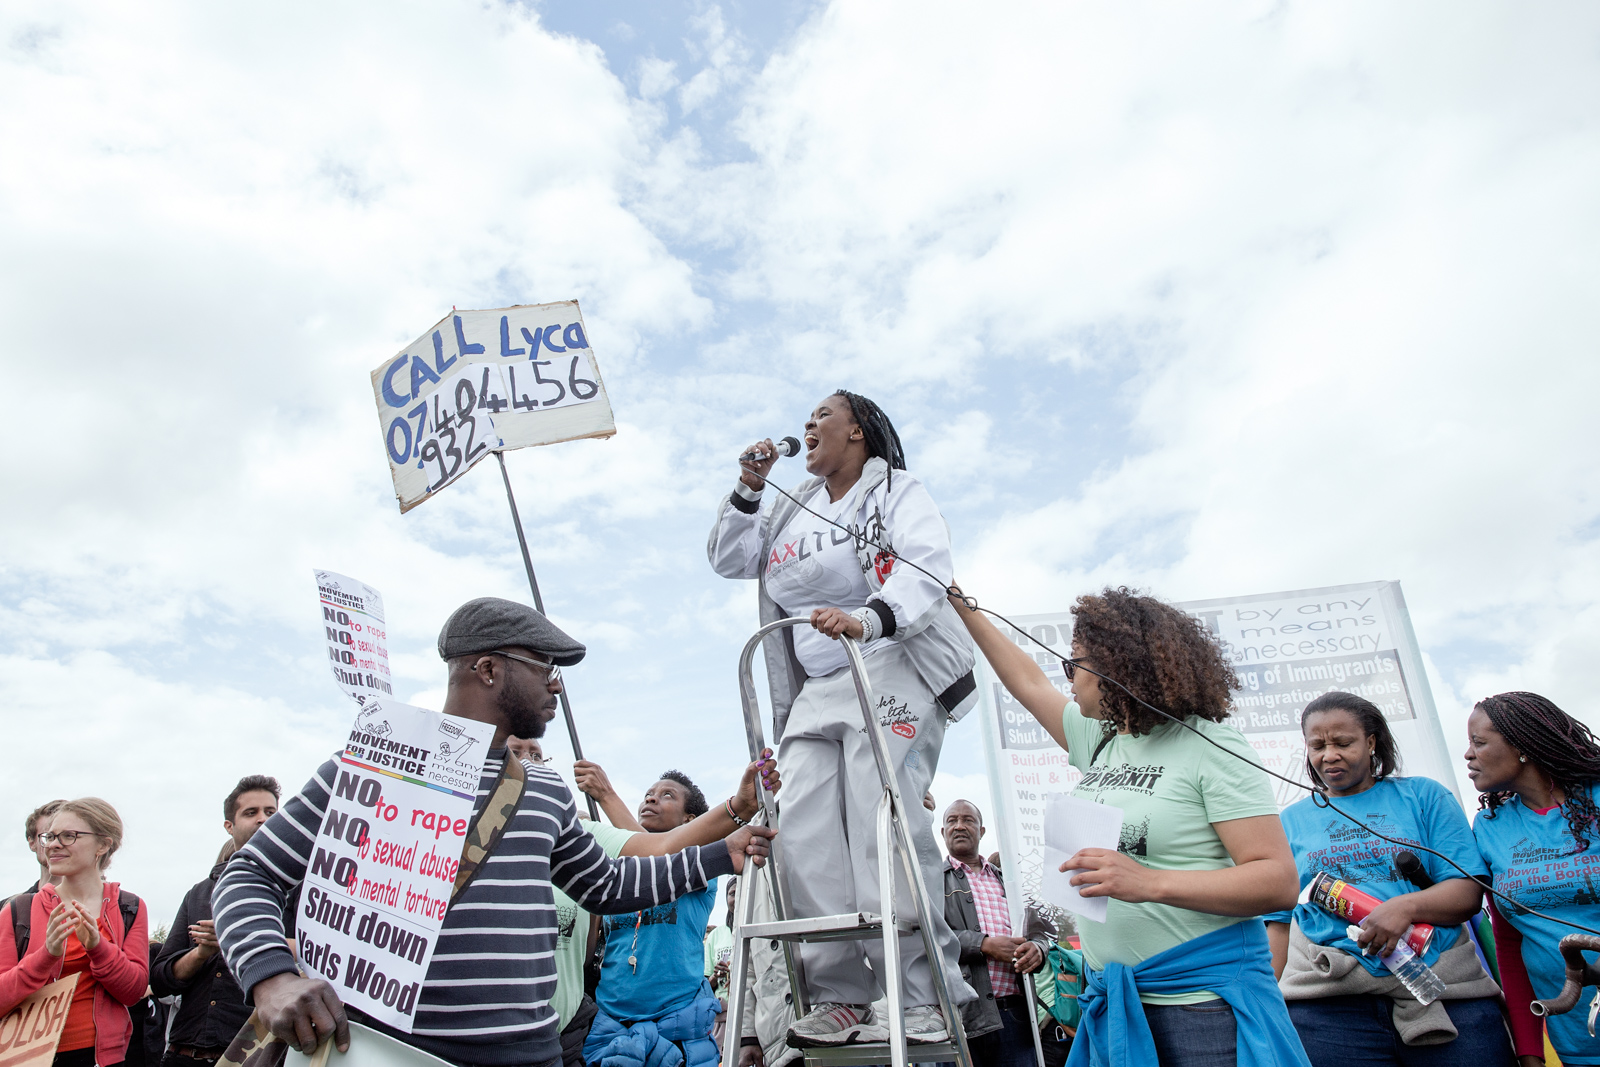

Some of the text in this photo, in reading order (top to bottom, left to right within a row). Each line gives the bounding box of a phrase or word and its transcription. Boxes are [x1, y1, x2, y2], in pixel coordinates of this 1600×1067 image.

[382, 315, 589, 408] CALL Lyca
[421, 415, 487, 491] 932
[318, 586, 364, 603] MOVEMENT
[333, 595, 365, 611] JUSTICE
[1235, 607, 1283, 622] by
[1296, 597, 1372, 615] any
[323, 606, 350, 626] NO
[348, 619, 362, 632] to
[366, 625, 387, 641] rape
[1240, 614, 1377, 639] means
[326, 626, 352, 646] NO
[347, 634, 356, 651] to
[1243, 632, 1382, 661] necessary
[328, 646, 355, 666] NO
[350, 654, 358, 669] to
[333, 666, 393, 696] Shut down
[1263, 664, 1281, 685] of
[1287, 655, 1395, 687] Immigrants
[1004, 709, 1035, 727] Ope
[1232, 688, 1324, 709] mmigration
[441, 722, 463, 736] FREEDOM
[1008, 728, 1038, 744] Shut
[1249, 710, 1290, 728] Raids
[349, 730, 431, 762] MOVEMENT
[345, 743, 427, 777] FOR JUSTICE
[431, 763, 479, 780] means
[433, 753, 482, 772] by any
[1011, 752, 1069, 768] Building
[1121, 762, 1166, 774] Racist
[428, 770, 478, 793] necessary
[1014, 771, 1041, 785] civil
[1048, 771, 1060, 784] &
[1016, 789, 1037, 801] We
[1119, 786, 1155, 797] Poverty
[335, 770, 467, 840] NO to rape
[1018, 806, 1039, 816] we
[1020, 821, 1041, 831] we
[322, 808, 459, 884] NO to sexual abuse
[1306, 847, 1328, 861] Tear
[1330, 840, 1361, 854] Down
[1362, 839, 1381, 850] The
[1321, 844, 1415, 868] Open the Border
[1512, 847, 1561, 859] MOVEMENT
[1507, 865, 1540, 879] Down
[1544, 861, 1569, 872] The
[1573, 854, 1600, 867] Fen
[310, 847, 448, 922] NO to mental torture
[1497, 879, 1523, 894] Open
[1526, 874, 1550, 886] the
[304, 886, 429, 966] Shut down
[297, 927, 420, 1017] Yarls Wood
